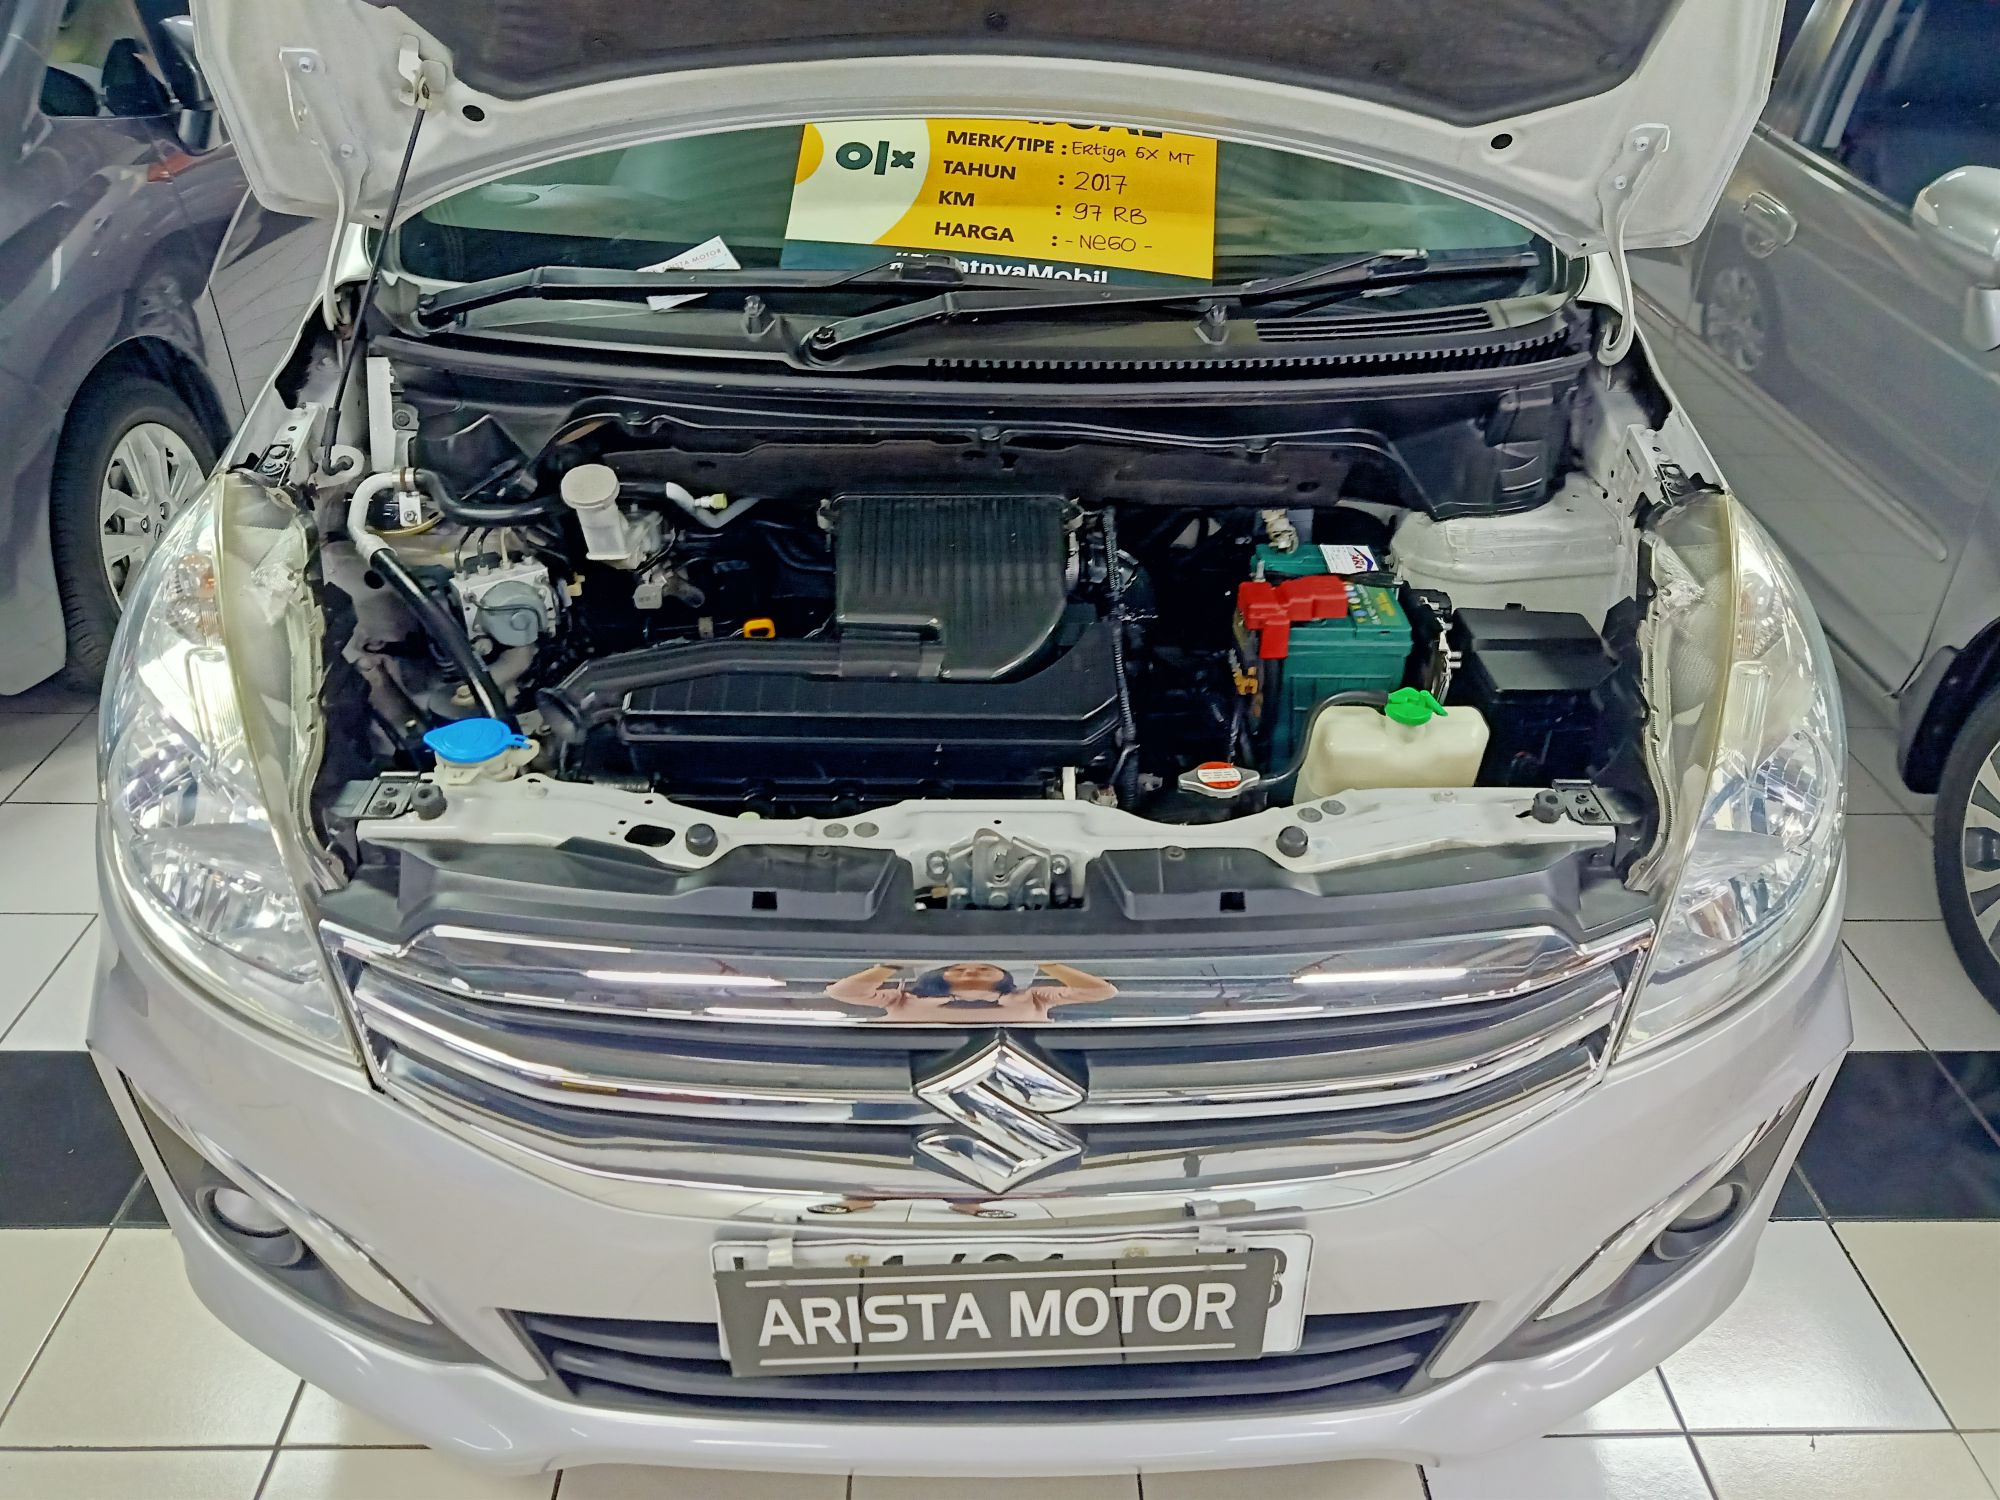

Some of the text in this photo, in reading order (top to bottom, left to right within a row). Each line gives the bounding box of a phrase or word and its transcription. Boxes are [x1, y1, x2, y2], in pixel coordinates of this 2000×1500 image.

[836, 140, 916, 175] olx
[946, 130, 1055, 154] MERK/TIPE
[1168, 150, 1197, 165] MT
[943, 160, 1017, 180] TAHUN
[1073, 171, 1128, 195] 2017
[938, 190, 975, 207] KM
[1072, 202, 1103, 222] 97
[1113, 206, 1148, 225] RB
[934, 221, 1015, 242] HARGA
[758, 1282, 1236, 1347] ARISTA MOTOR
